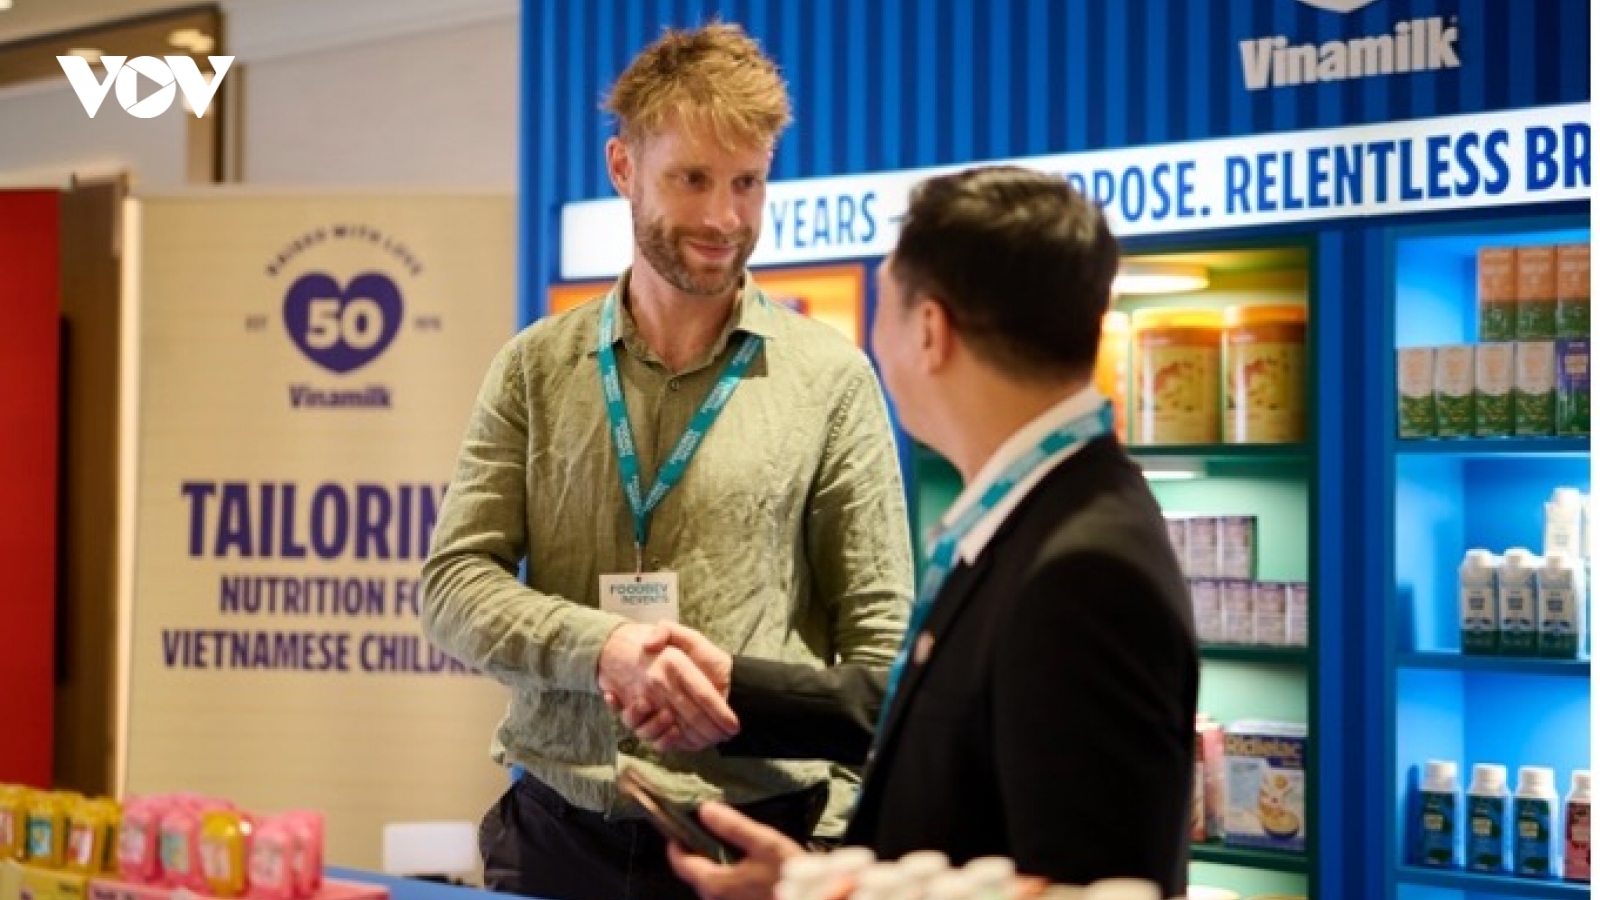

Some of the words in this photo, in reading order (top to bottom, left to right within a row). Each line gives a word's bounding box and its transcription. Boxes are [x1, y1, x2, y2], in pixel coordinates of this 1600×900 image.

[1239, 18, 1461, 90] Vinamilk
[770, 192, 877, 250] YEARS
[1226, 129, 1510, 215] RELENTLESS
[1526, 123, 1591, 191] BR
[332, 225, 382, 243] WITH
[305, 298, 384, 350] 50
[289, 384, 392, 409] Vinamilk
[219, 576, 386, 617] NUTRITION
[162, 630, 351, 672] VIETNAMESE
